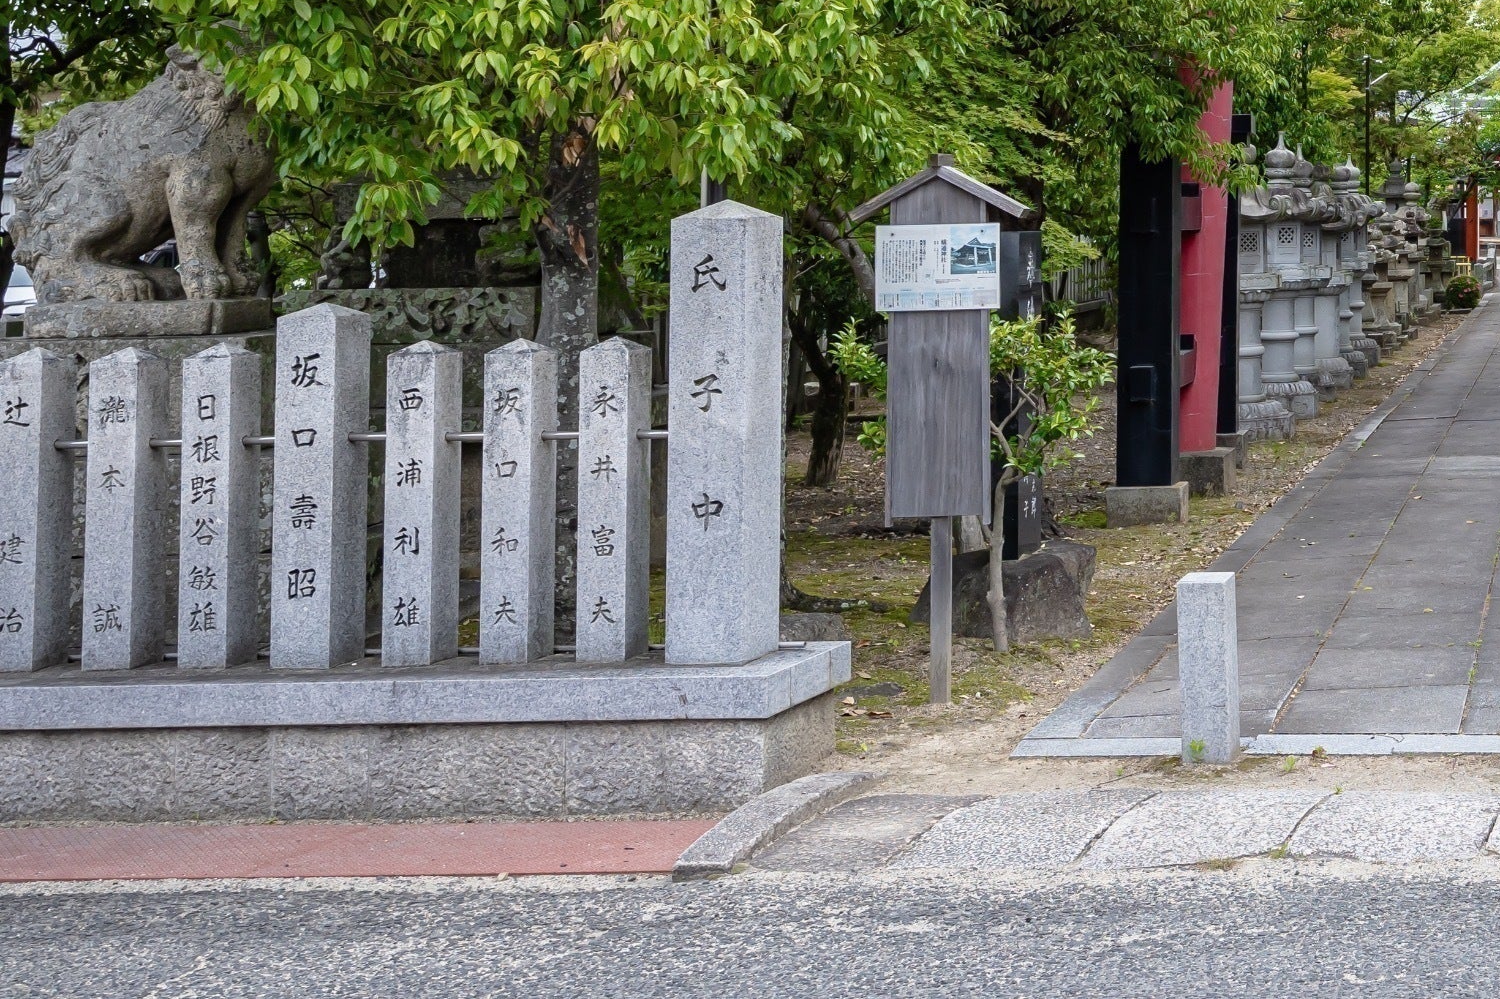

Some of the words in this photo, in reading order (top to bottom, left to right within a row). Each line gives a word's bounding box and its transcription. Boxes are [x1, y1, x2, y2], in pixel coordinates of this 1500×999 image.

[287, 352, 325, 600] 坂口壽昭
[392, 387, 424, 628] 西浦利雄
[490, 387, 523, 626] 坂口和夫
[589, 385, 619, 625] 永井富夫
[690, 253, 728, 533] 氏子中
[0, 396, 30, 633] 辻建治
[188, 394, 221, 633] 日根野谷敏雄
